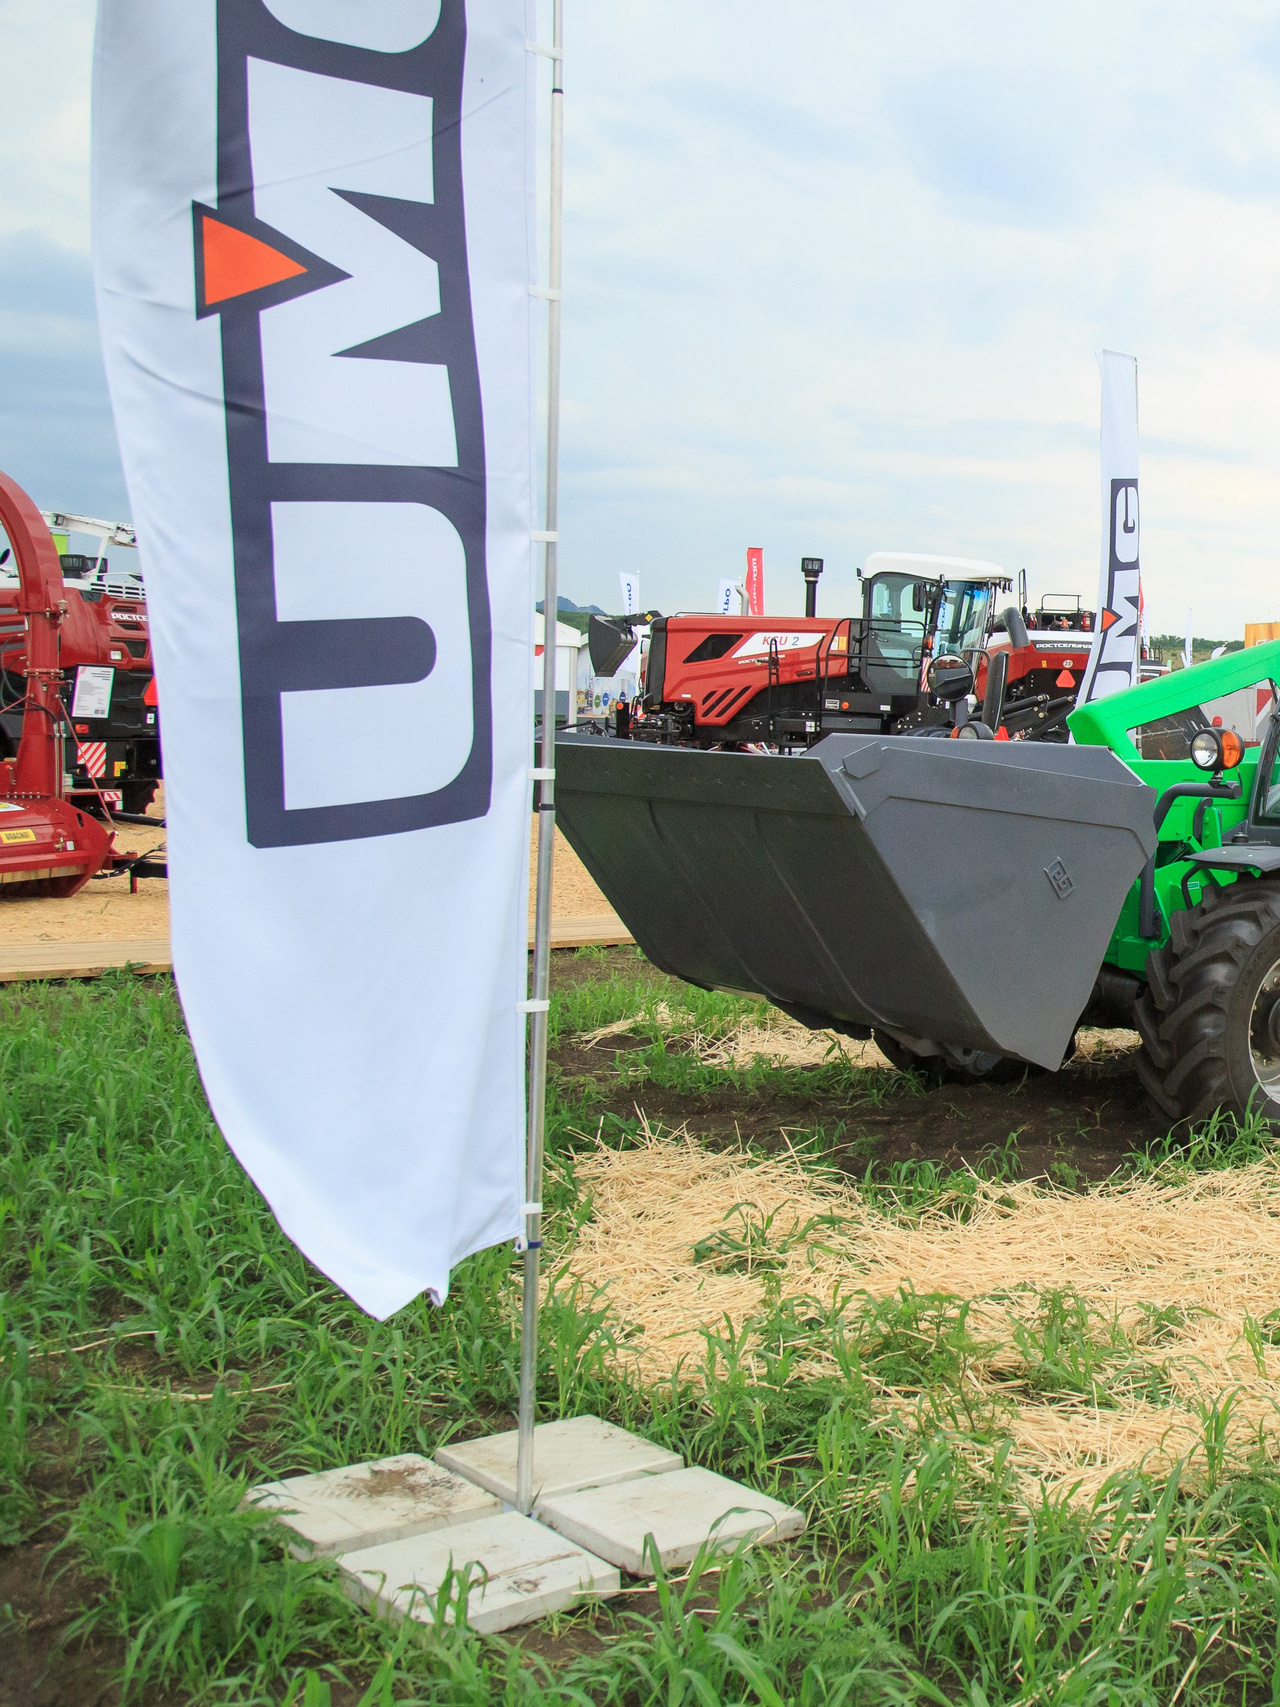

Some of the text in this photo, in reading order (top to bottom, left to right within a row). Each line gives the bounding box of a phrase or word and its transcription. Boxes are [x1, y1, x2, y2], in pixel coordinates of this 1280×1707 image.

[246, 0, 474, 812] UM
[110, 612, 149, 622] РОСТСЕ
[791, 636, 799, 646] 2
